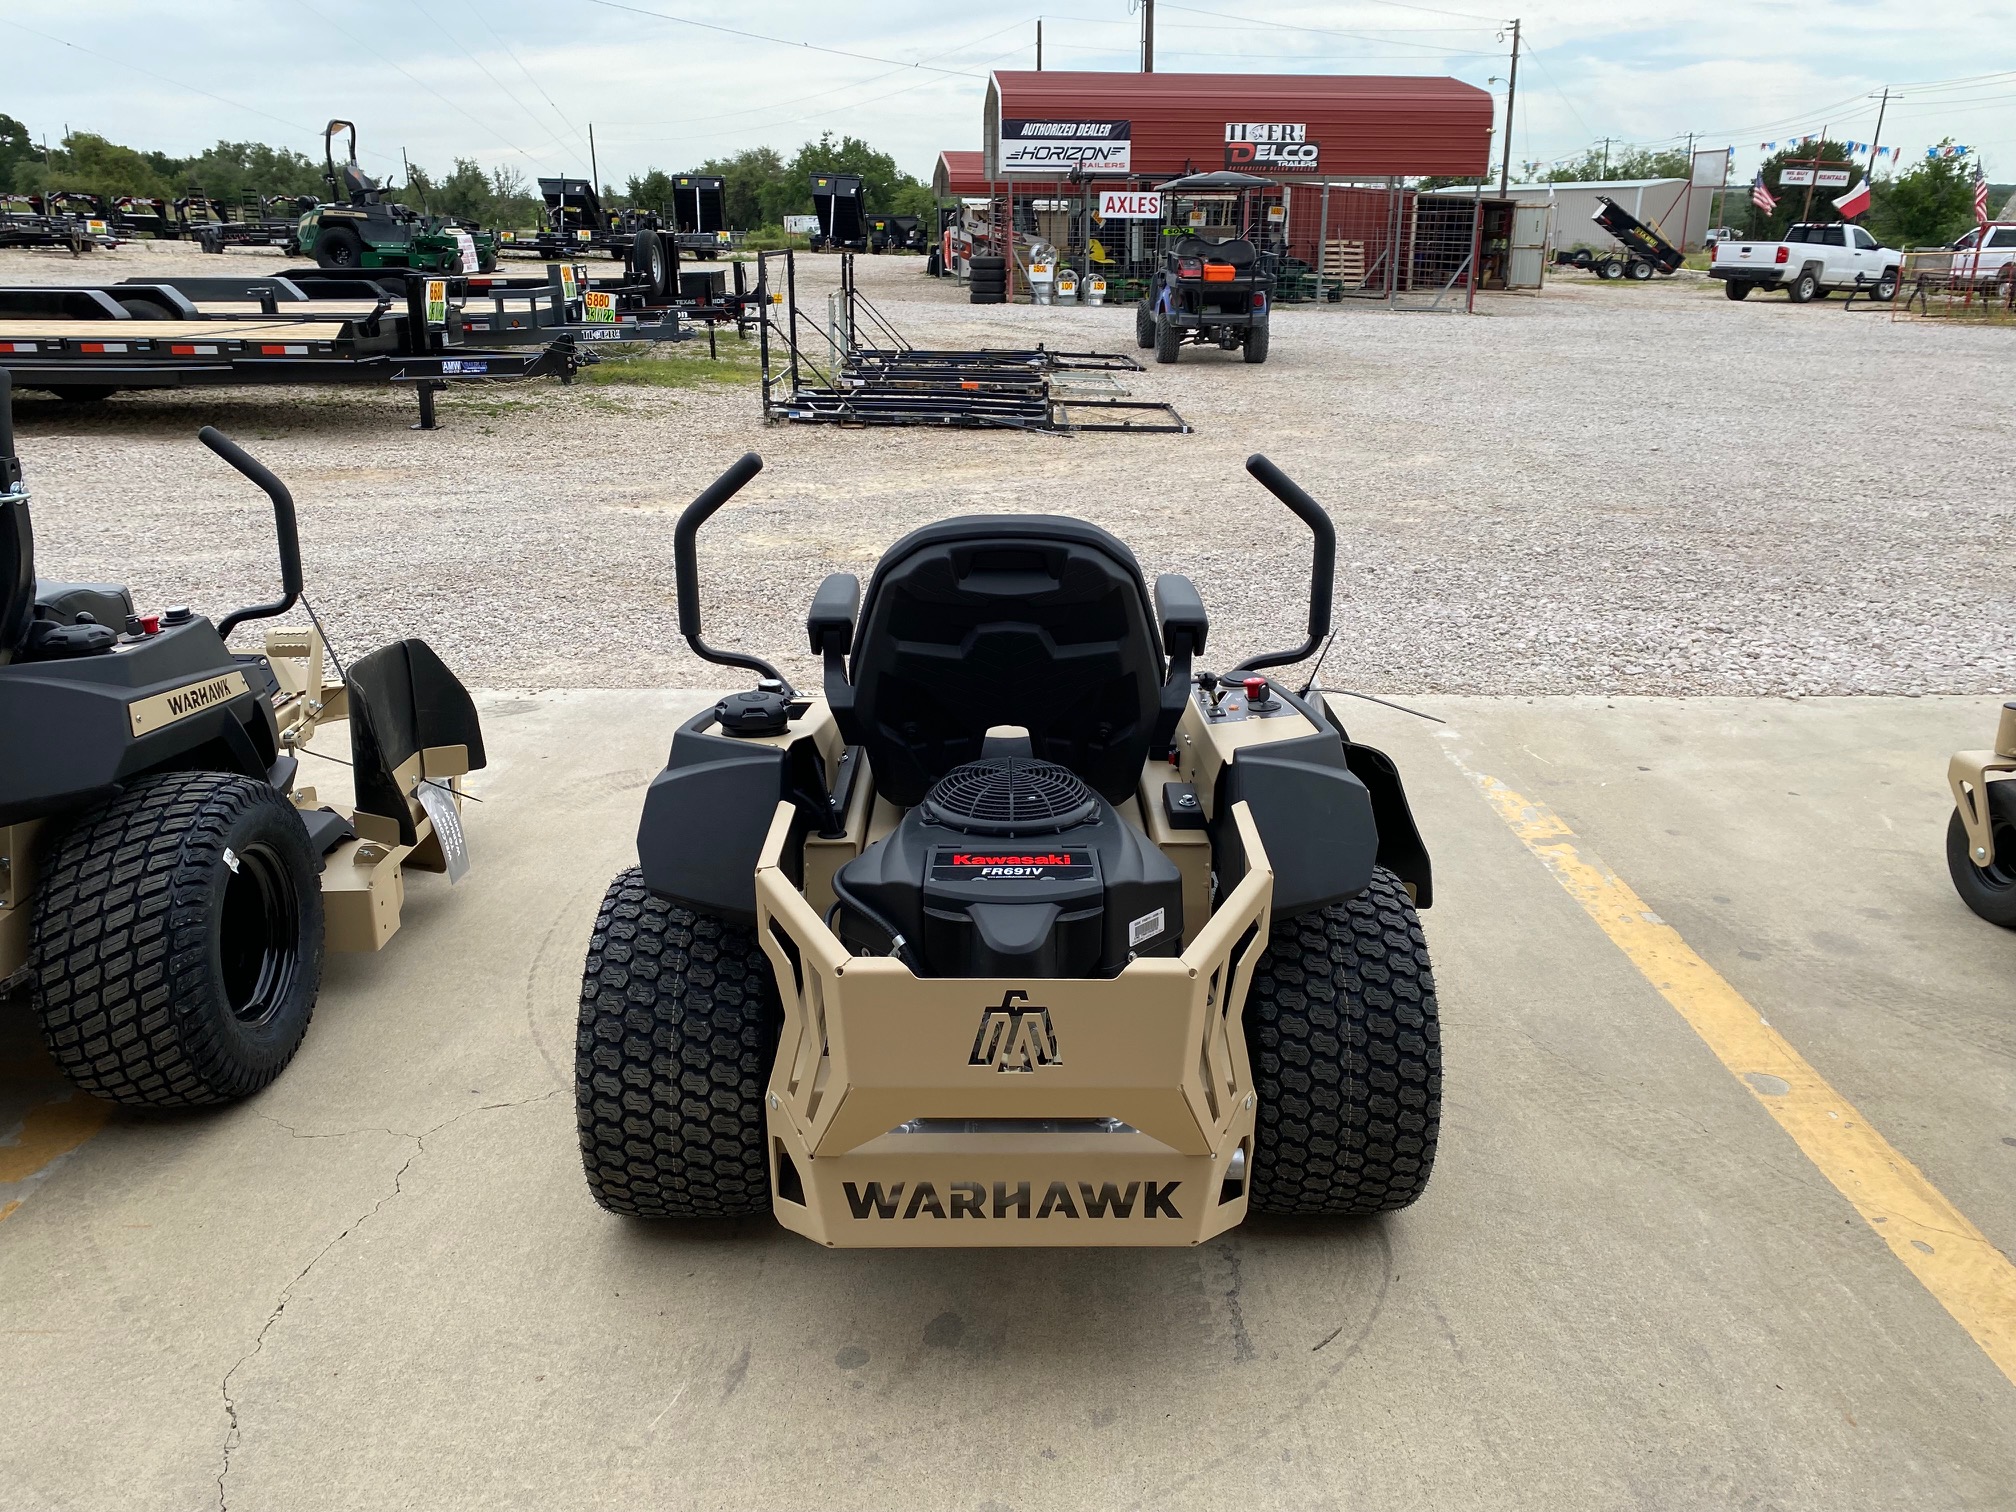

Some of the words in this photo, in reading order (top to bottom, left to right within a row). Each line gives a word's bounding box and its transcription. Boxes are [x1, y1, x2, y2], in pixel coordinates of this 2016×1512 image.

[1021, 123, 1077, 136] AUTHORIZED
[1076, 124, 1112, 137] DEALER
[1018, 146, 1113, 160] HORIZON
[1228, 143, 1319, 163] DELCO
[1105, 196, 1159, 214] AXLES
[1061, 282, 1073, 290] 100
[1093, 282, 1105, 290] 150
[587, 293, 610, 308] 5880
[442, 361, 461, 370] AMW
[166, 678, 232, 715] WARHAWK
[440, 804, 461, 856] WARHAWK
[441, 817, 450, 836] THE
[449, 811, 463, 844] FAMILY
[433, 812, 452, 861] WELCOME
[448, 837, 455, 851] TO
[953, 854, 1071, 865] Kawasaki
[981, 867, 1044, 875] FR691V
[841, 1181, 1184, 1219] WARHAWK
